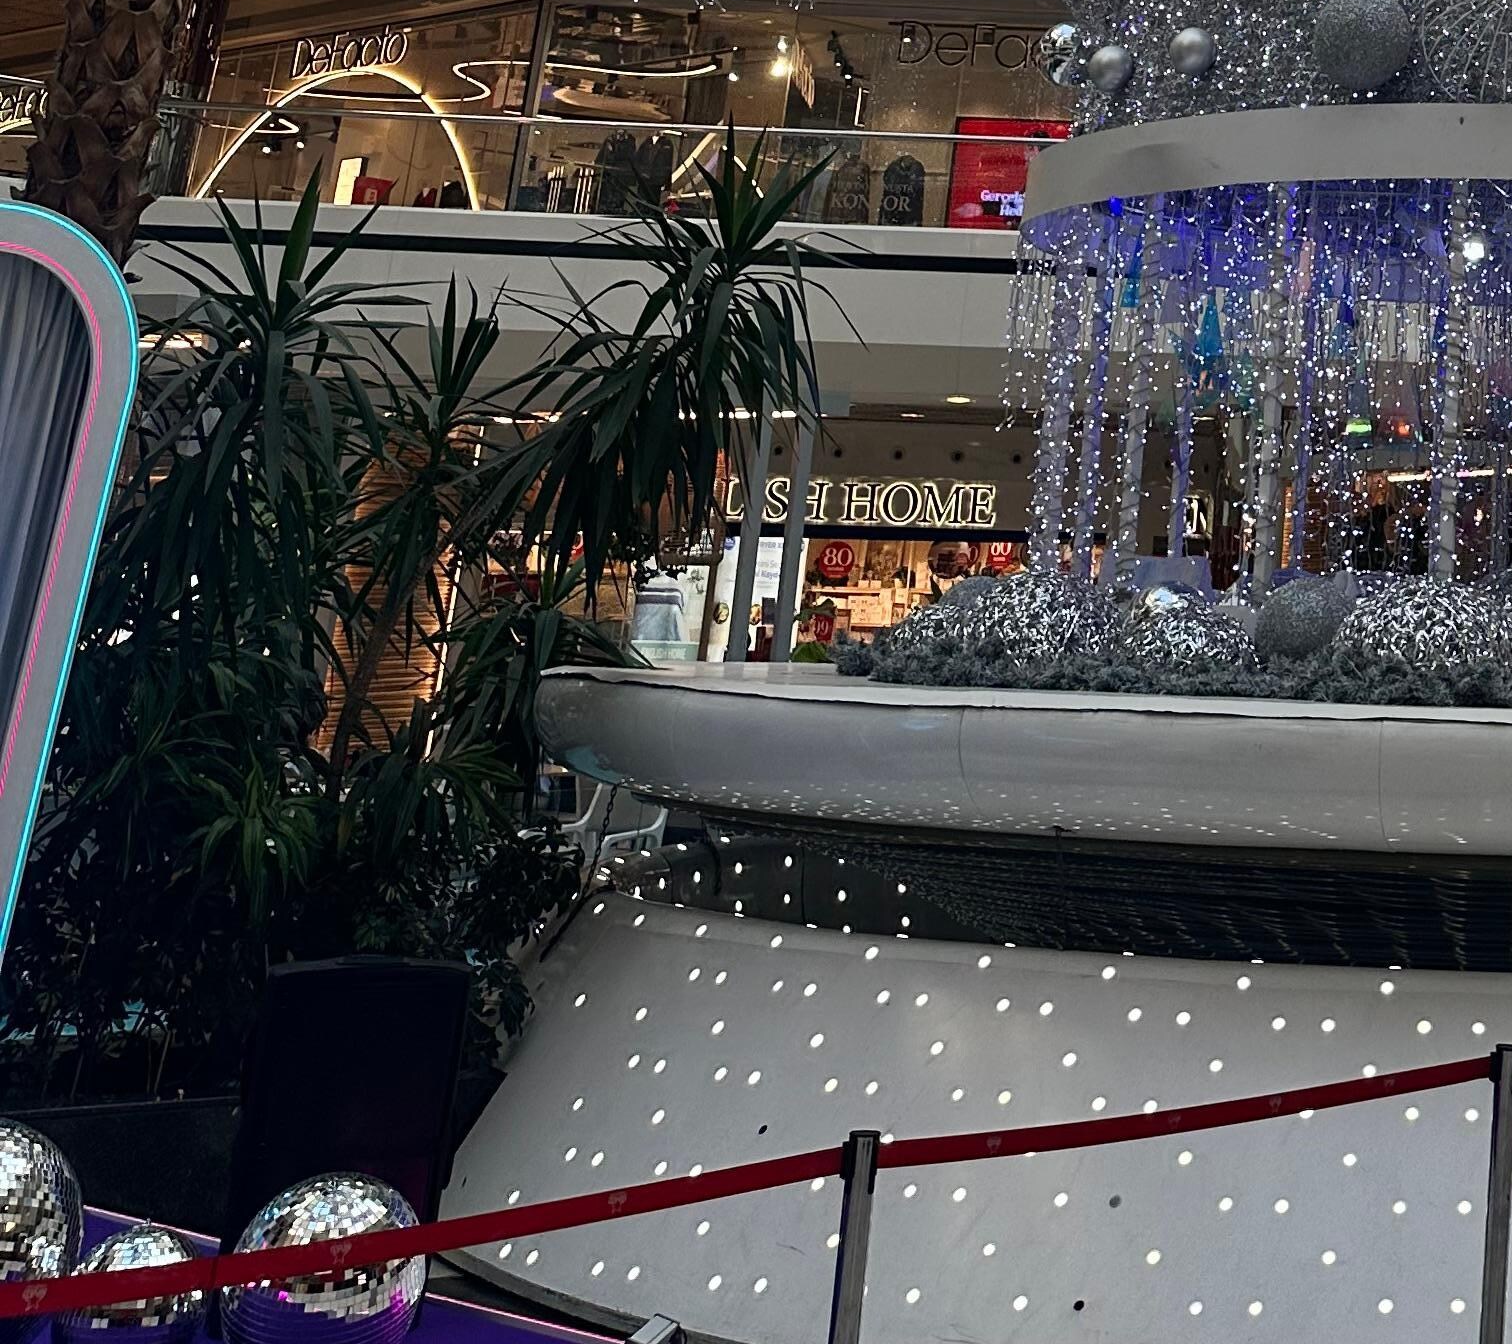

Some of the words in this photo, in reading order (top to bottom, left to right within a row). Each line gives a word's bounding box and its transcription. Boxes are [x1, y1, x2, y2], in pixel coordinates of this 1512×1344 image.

[291, 25, 410, 81] DeFacto
[840, 481, 998, 528] HOME
[822, 547, 854, 567] 80
